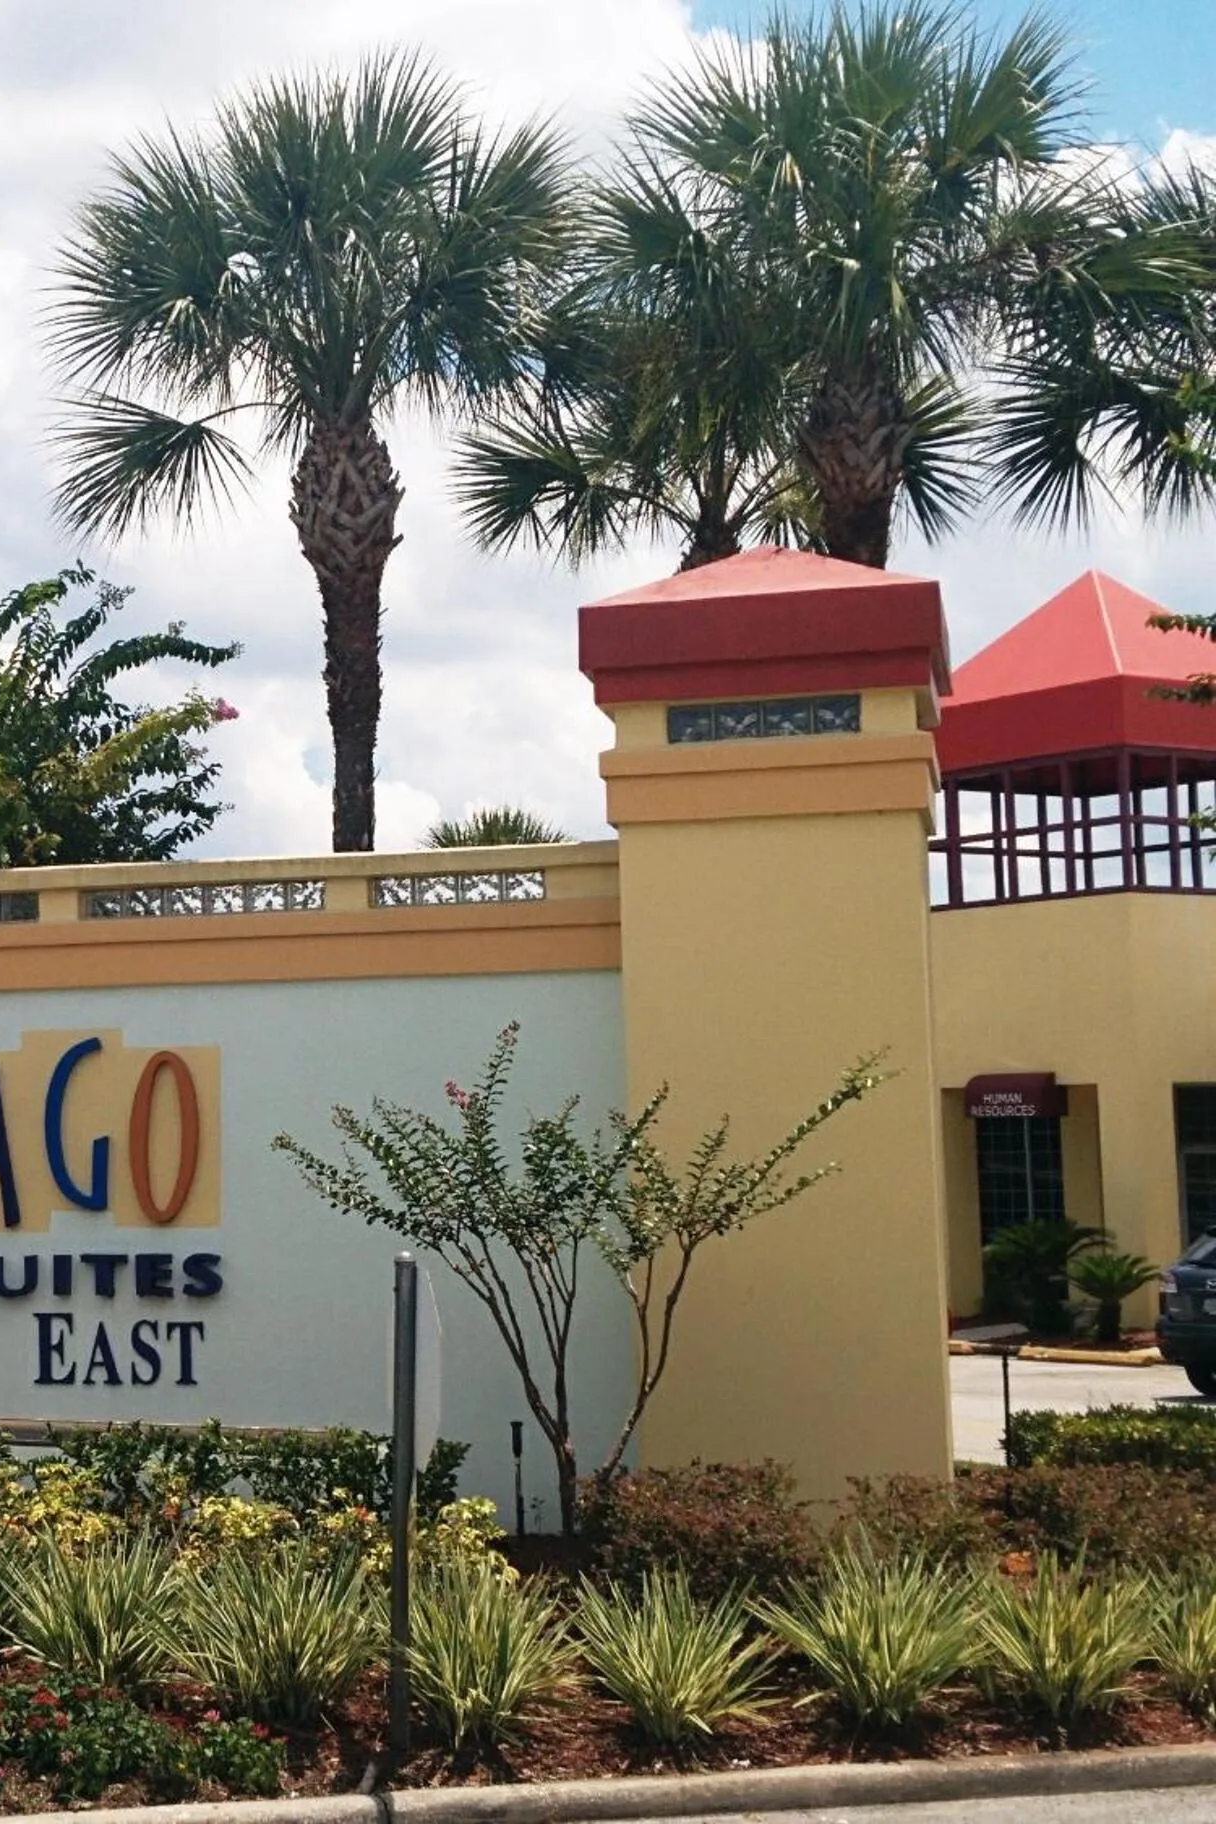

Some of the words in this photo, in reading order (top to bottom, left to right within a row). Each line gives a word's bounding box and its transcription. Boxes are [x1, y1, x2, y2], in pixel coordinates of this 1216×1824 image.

[983, 1093, 1023, 1104] HUMAN
[971, 1105, 1036, 1117] RESOURCES
[34, 1313, 204, 1386] EAST
